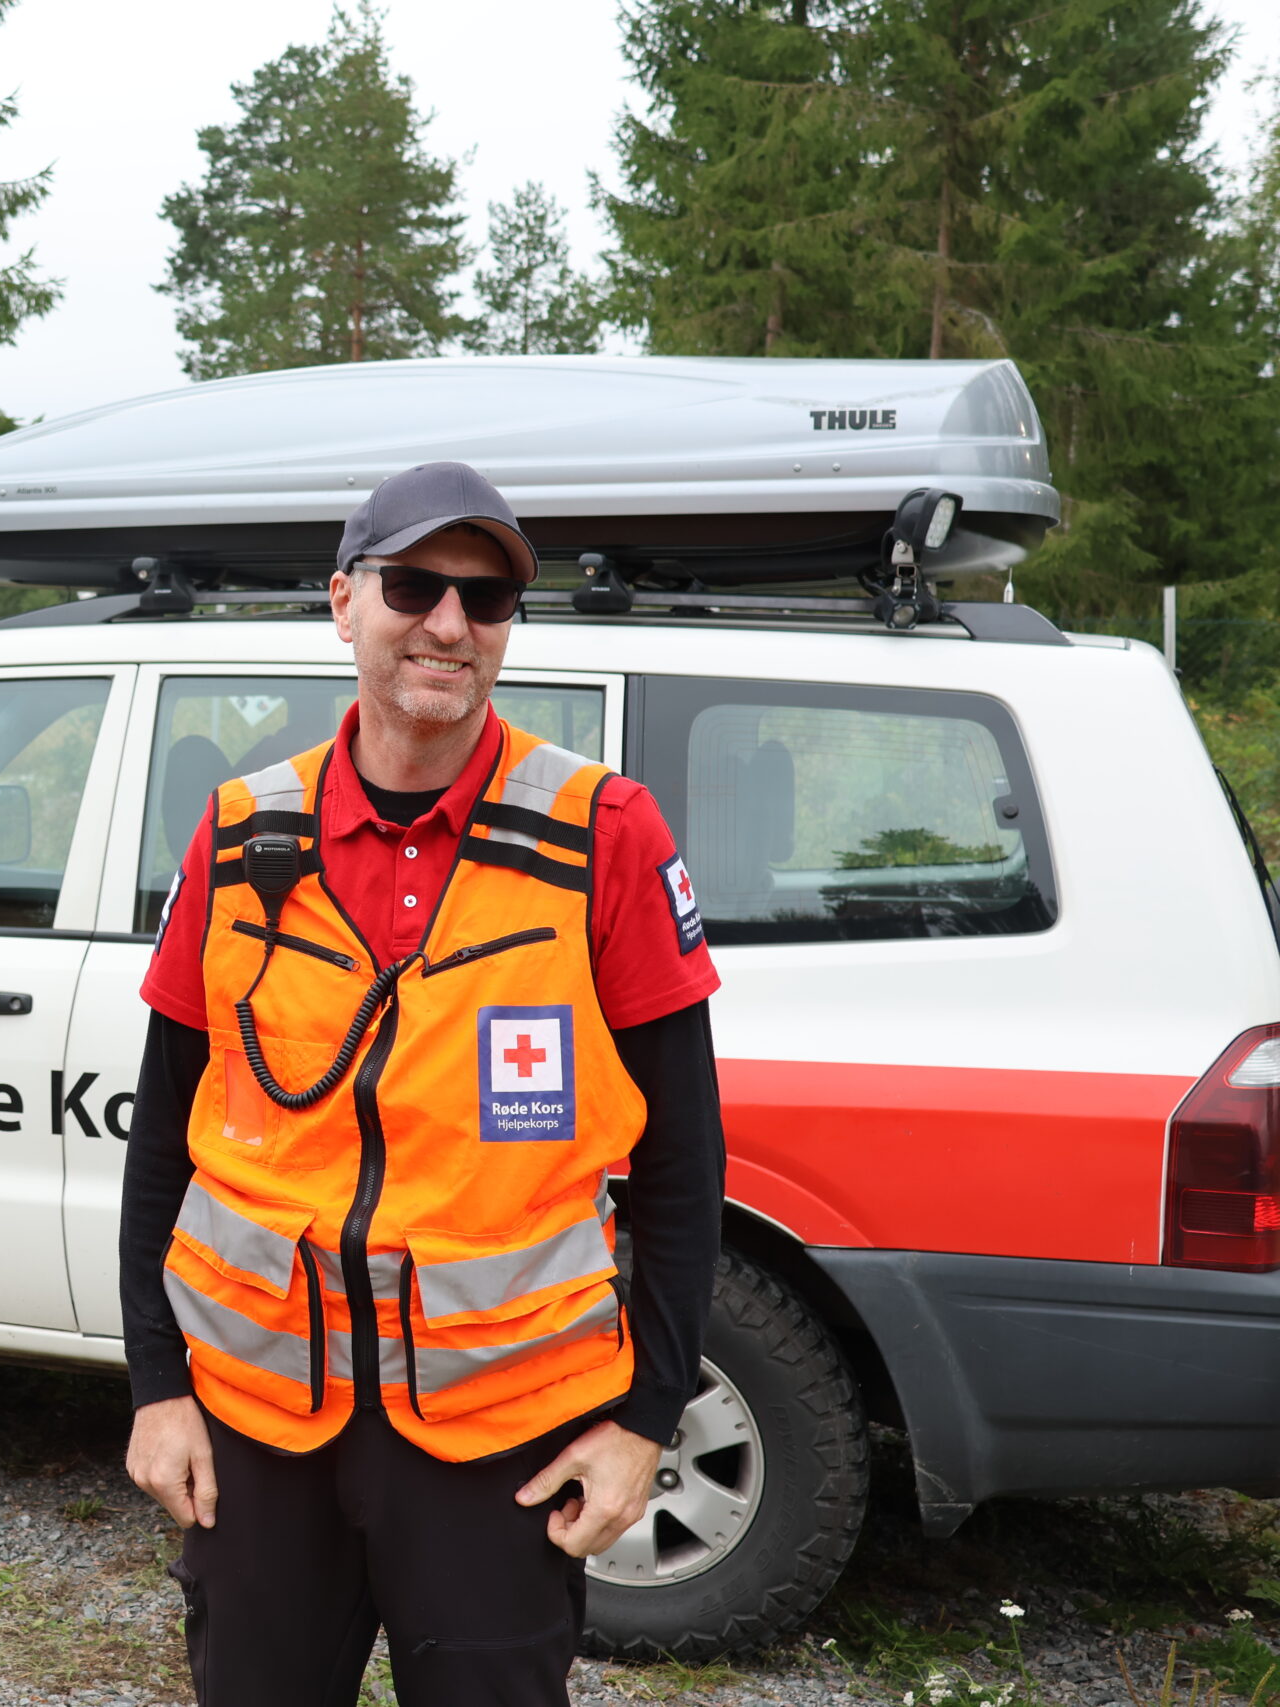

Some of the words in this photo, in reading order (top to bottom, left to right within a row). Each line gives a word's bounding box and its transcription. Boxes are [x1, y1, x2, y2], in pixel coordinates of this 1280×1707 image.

[810, 410, 896, 430] THULE
[492, 1101, 528, 1115] Røde
[531, 1101, 564, 1114] Kors
[497, 1117, 559, 1132] Hjelpekorps
